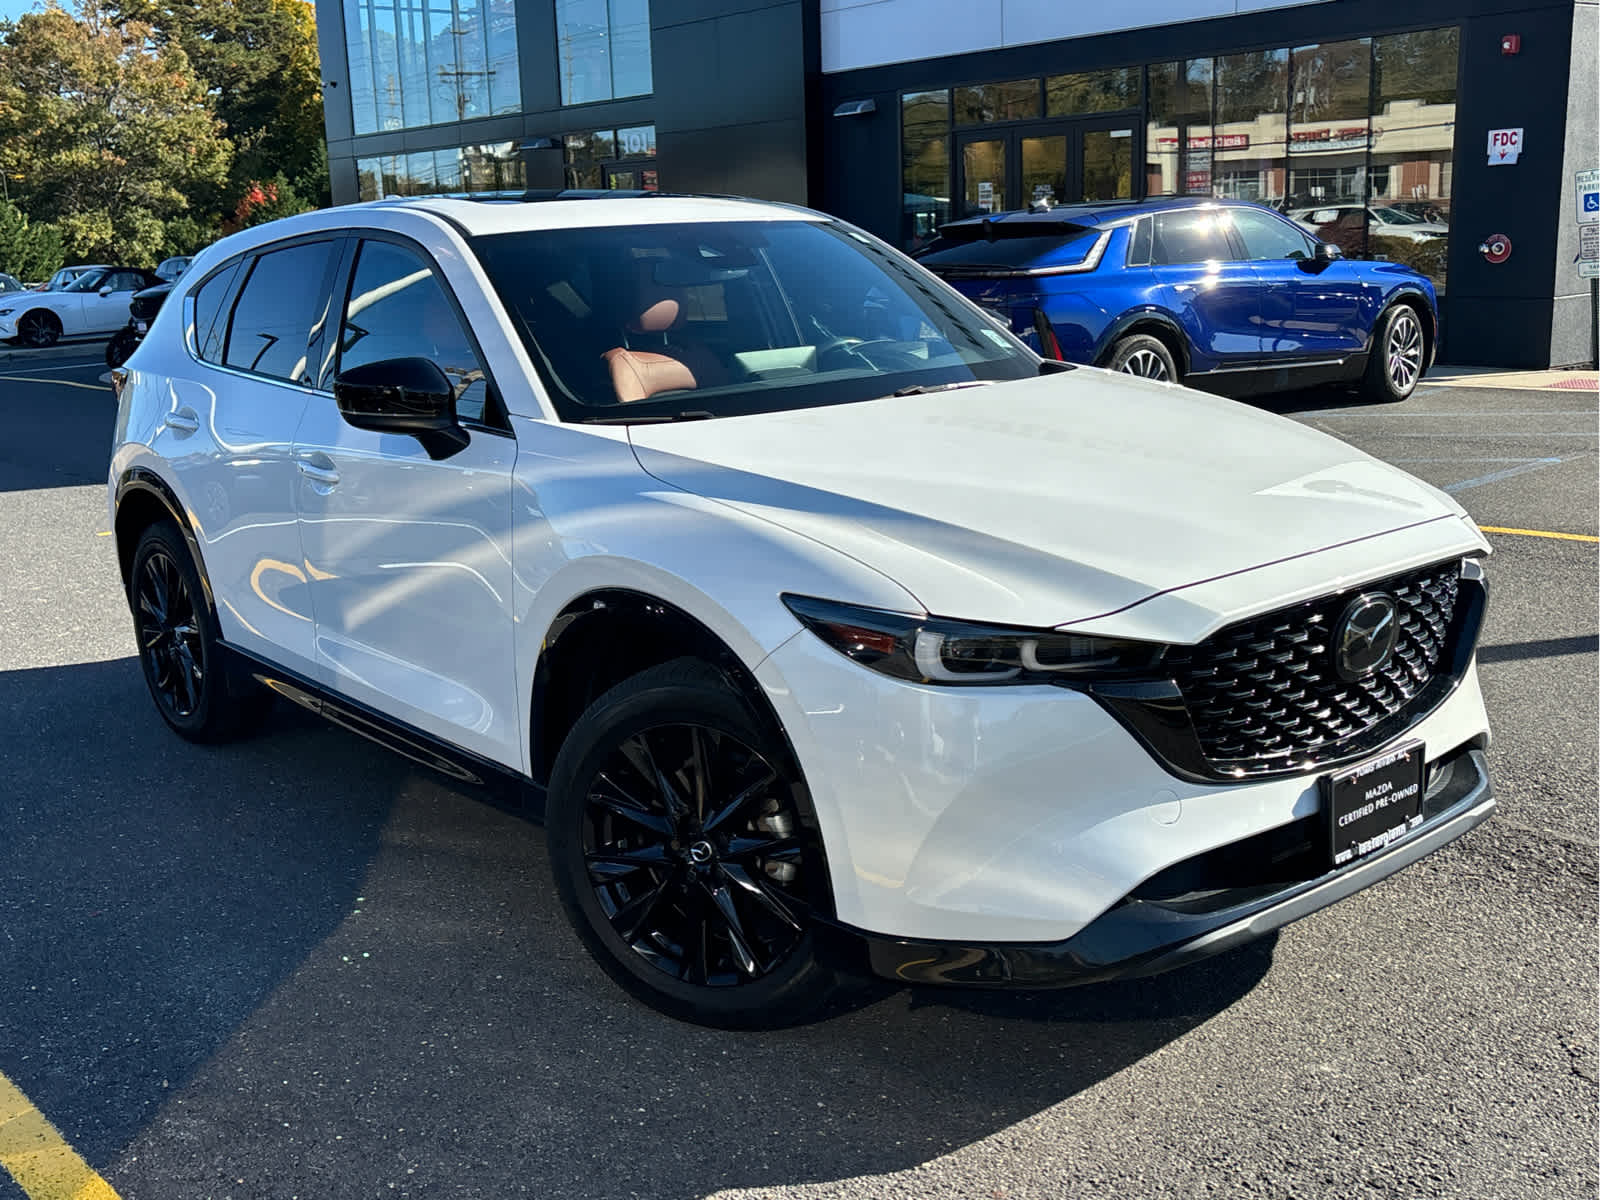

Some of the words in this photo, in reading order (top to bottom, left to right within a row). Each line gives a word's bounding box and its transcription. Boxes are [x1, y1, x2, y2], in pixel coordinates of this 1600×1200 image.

[1492, 131, 1518, 146] FDC
[1365, 781, 1393, 801] MAZDA
[1338, 803, 1374, 827] CERTIFIED
[1375, 783, 1418, 810] PRE-OWNED
